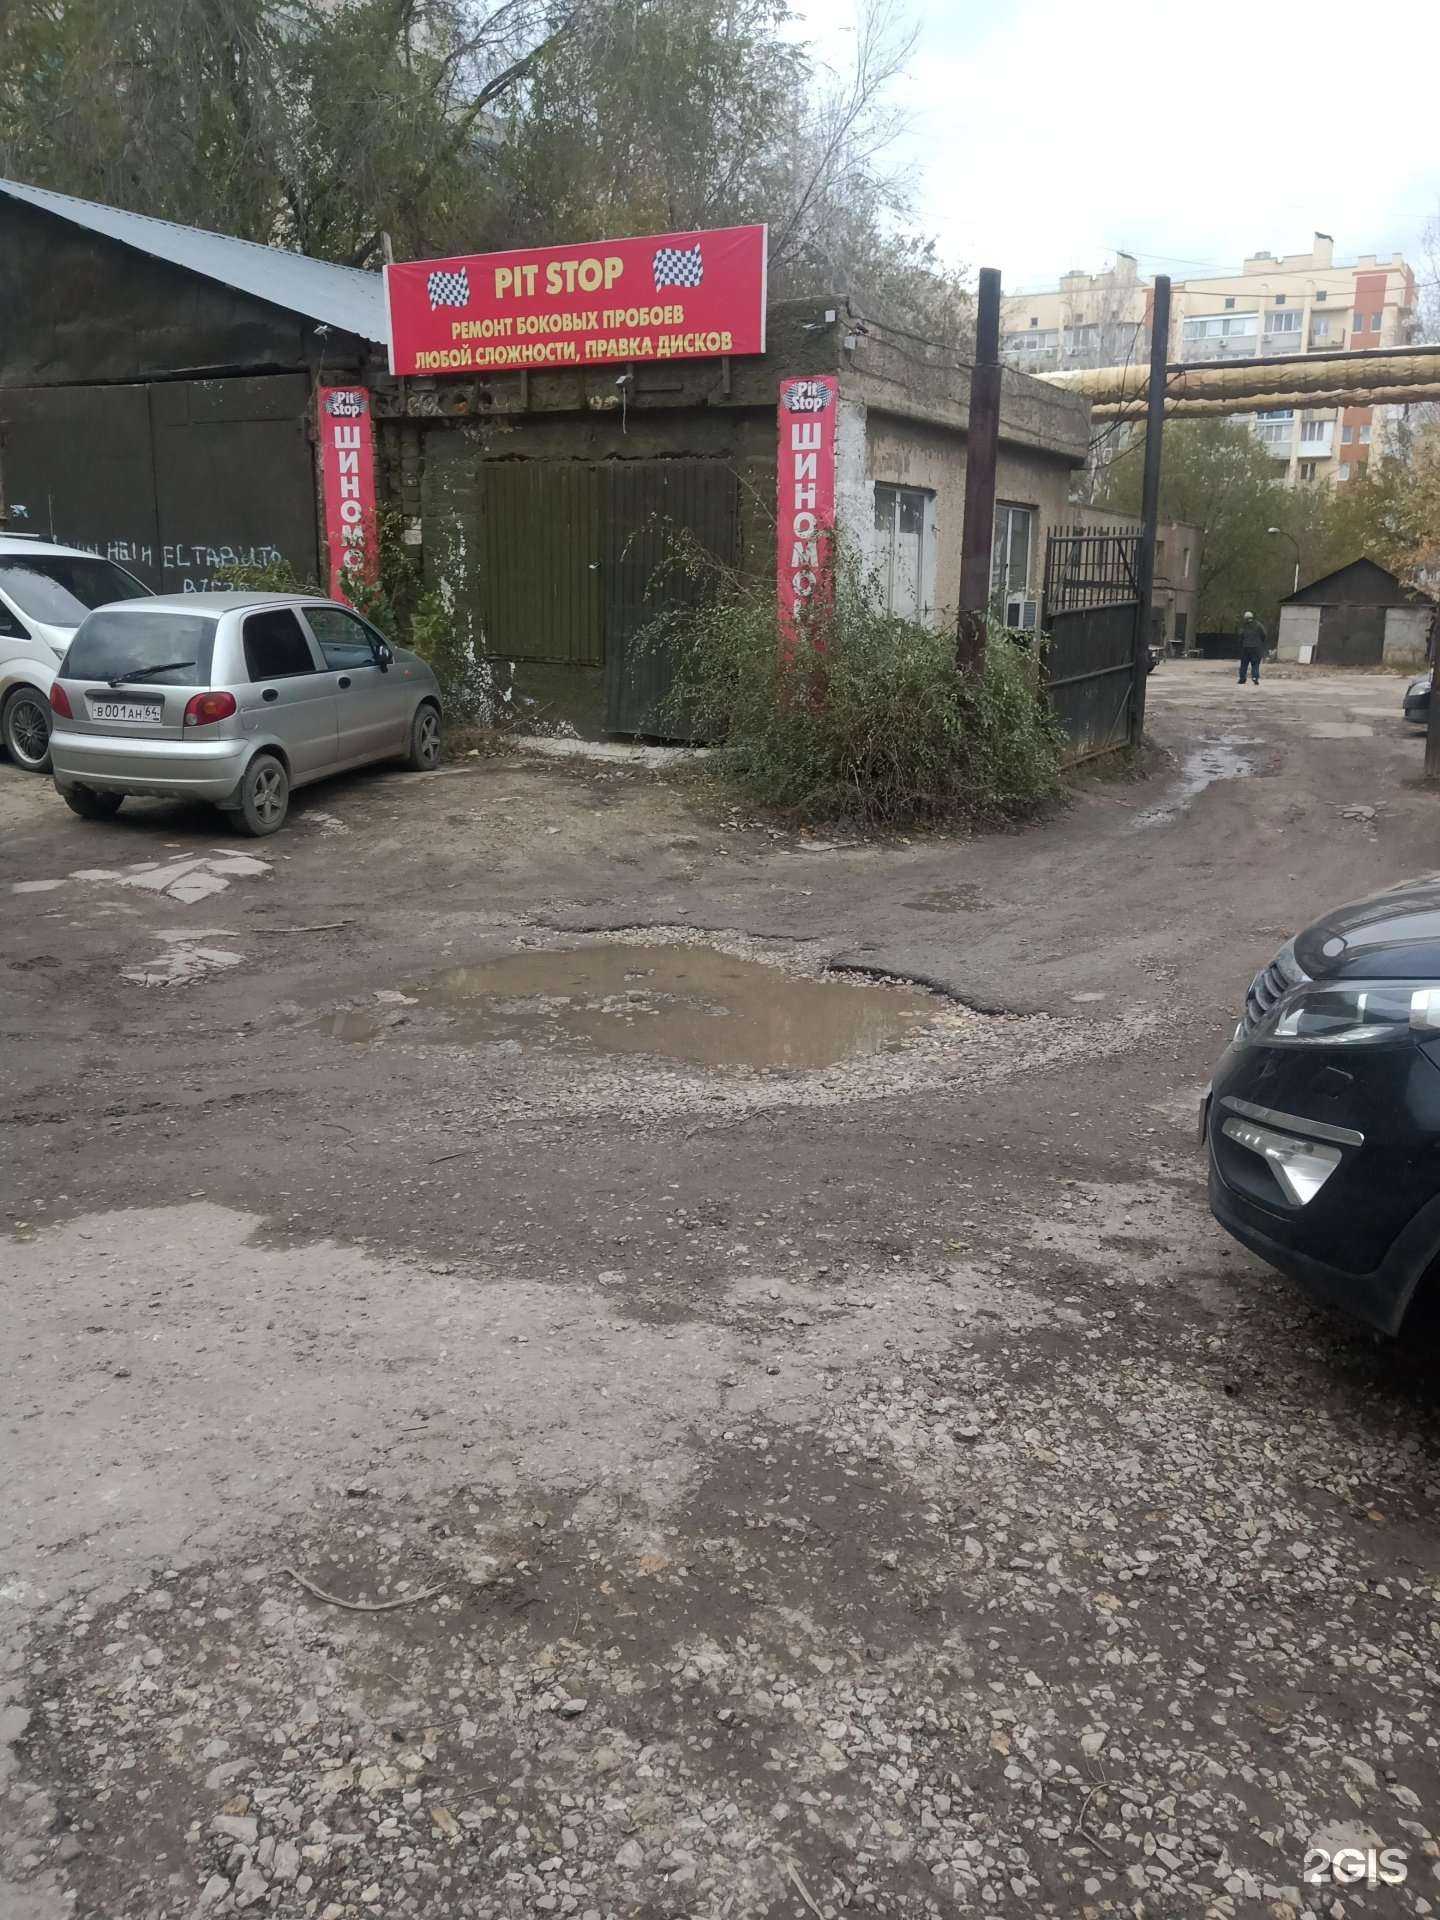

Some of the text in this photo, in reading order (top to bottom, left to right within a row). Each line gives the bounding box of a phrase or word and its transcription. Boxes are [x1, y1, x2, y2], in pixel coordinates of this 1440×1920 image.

[495, 257, 624, 299] PIT STOP
[451, 304, 684, 340] РЕМОНТ БОКОВЫХ ПРОБОЕВ
[415, 331, 733, 369] ЛЮБОЙ СЛОЖНОСТИ, ПРАВКА ДИСКОВ
[337, 391, 355, 404] Pit
[798, 381, 818, 396] Pit
[332, 403, 360, 418] Stop
[791, 396, 823, 412] Stop
[334, 426, 364, 586] ШИНОМО
